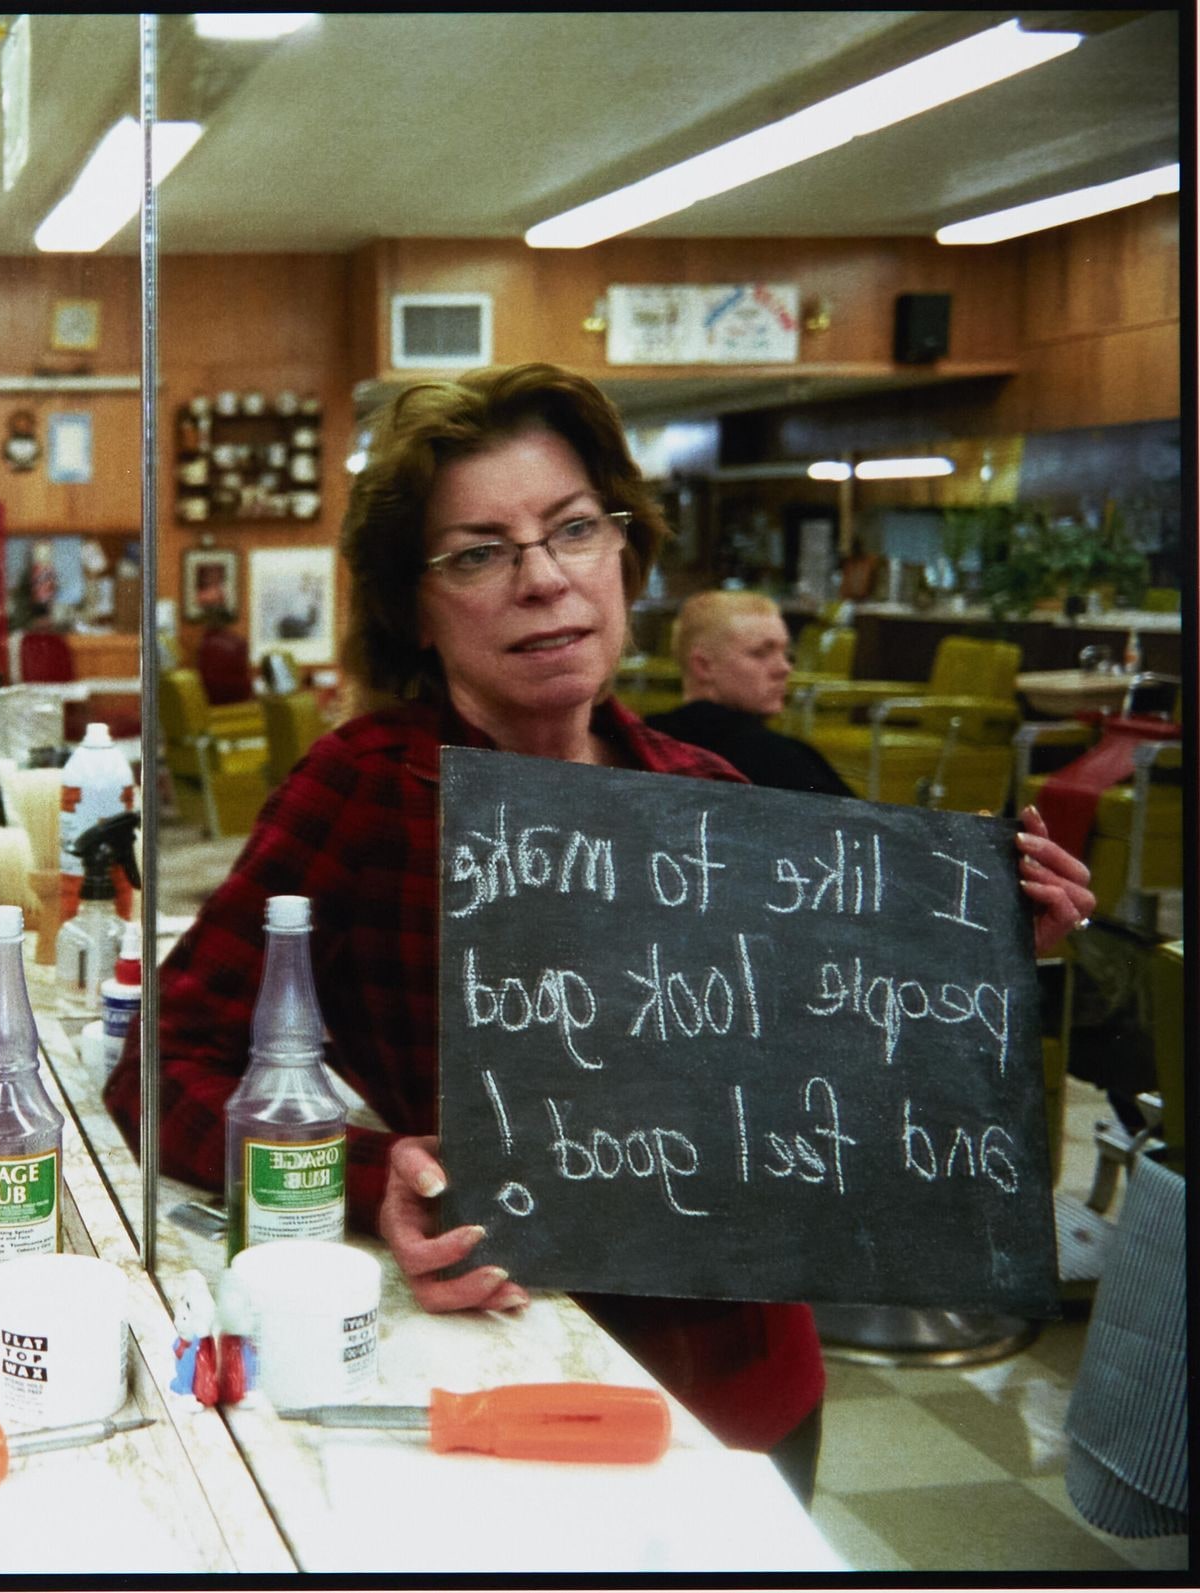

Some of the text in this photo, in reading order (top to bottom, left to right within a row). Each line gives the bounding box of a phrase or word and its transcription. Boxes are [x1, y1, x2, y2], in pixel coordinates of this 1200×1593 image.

[3, 1332, 45, 1351] FLAT
[5, 1347, 43, 1363] TOP
[3, 1360, 44, 1381] WAX
